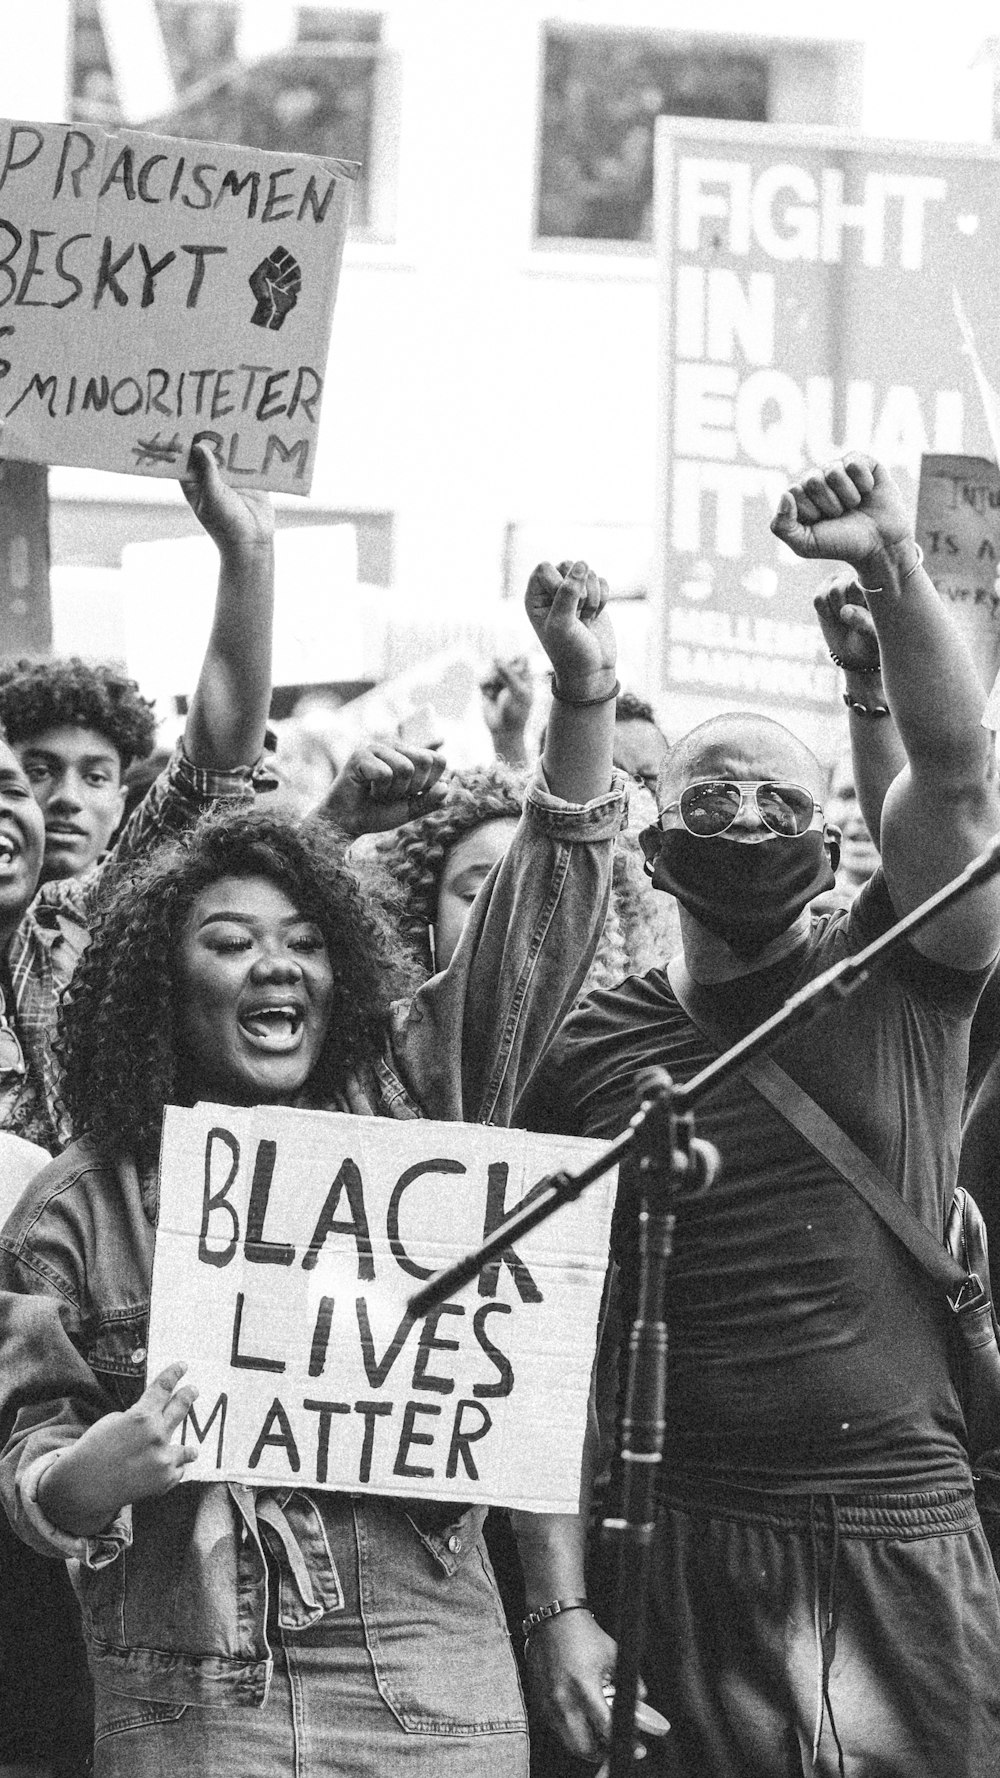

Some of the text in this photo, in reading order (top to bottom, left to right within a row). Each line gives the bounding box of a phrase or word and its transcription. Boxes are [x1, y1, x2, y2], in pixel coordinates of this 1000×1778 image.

[53, 130, 337, 225] RACISMEN
[677, 157, 948, 272] FIGHT
[675, 264, 776, 368] IN
[5, 363, 324, 424] MINORITETER
[197, 1126, 545, 1304] BLACK
[229, 1290, 515, 1398] LIVES
[180, 1392, 493, 1484] MATTER
